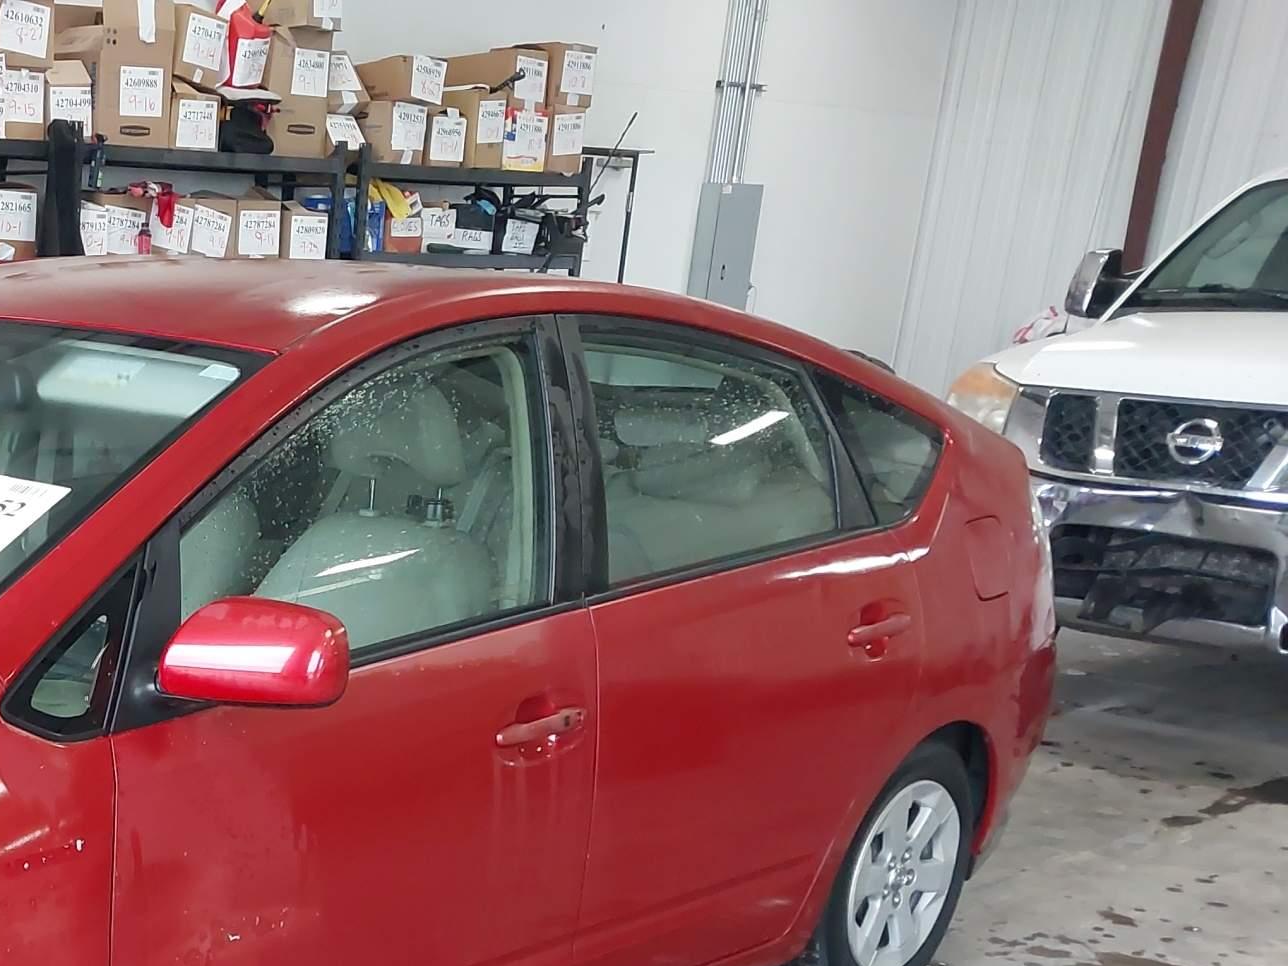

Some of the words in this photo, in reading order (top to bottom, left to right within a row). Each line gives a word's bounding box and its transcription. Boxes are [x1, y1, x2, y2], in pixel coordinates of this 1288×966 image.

[4, 8, 44, 27] 42610632
[5, 82, 39, 93] 42704310
[124, 77, 158, 89] 42609888
